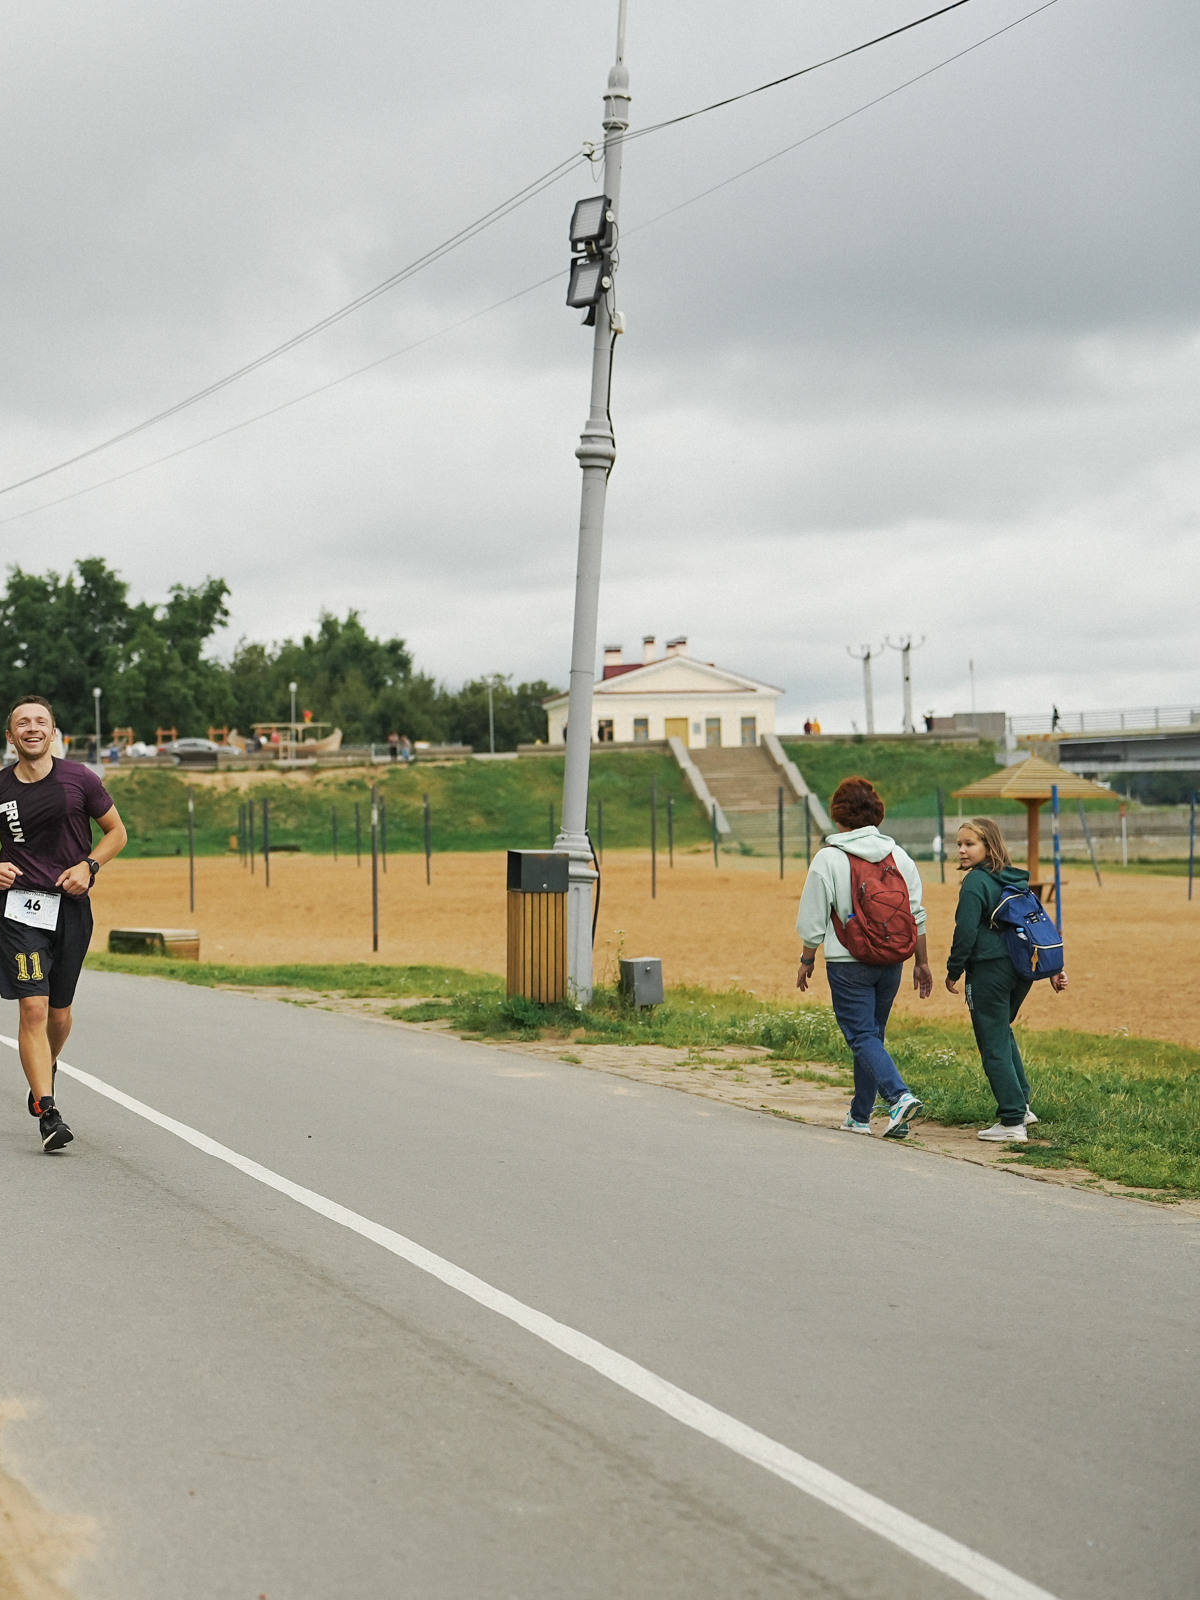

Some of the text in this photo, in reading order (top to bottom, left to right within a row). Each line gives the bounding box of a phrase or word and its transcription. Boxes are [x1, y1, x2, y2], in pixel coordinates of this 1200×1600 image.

[6, 808, 26, 843] RUN
[24, 899, 41, 911] 46
[15, 951, 44, 981] 11
